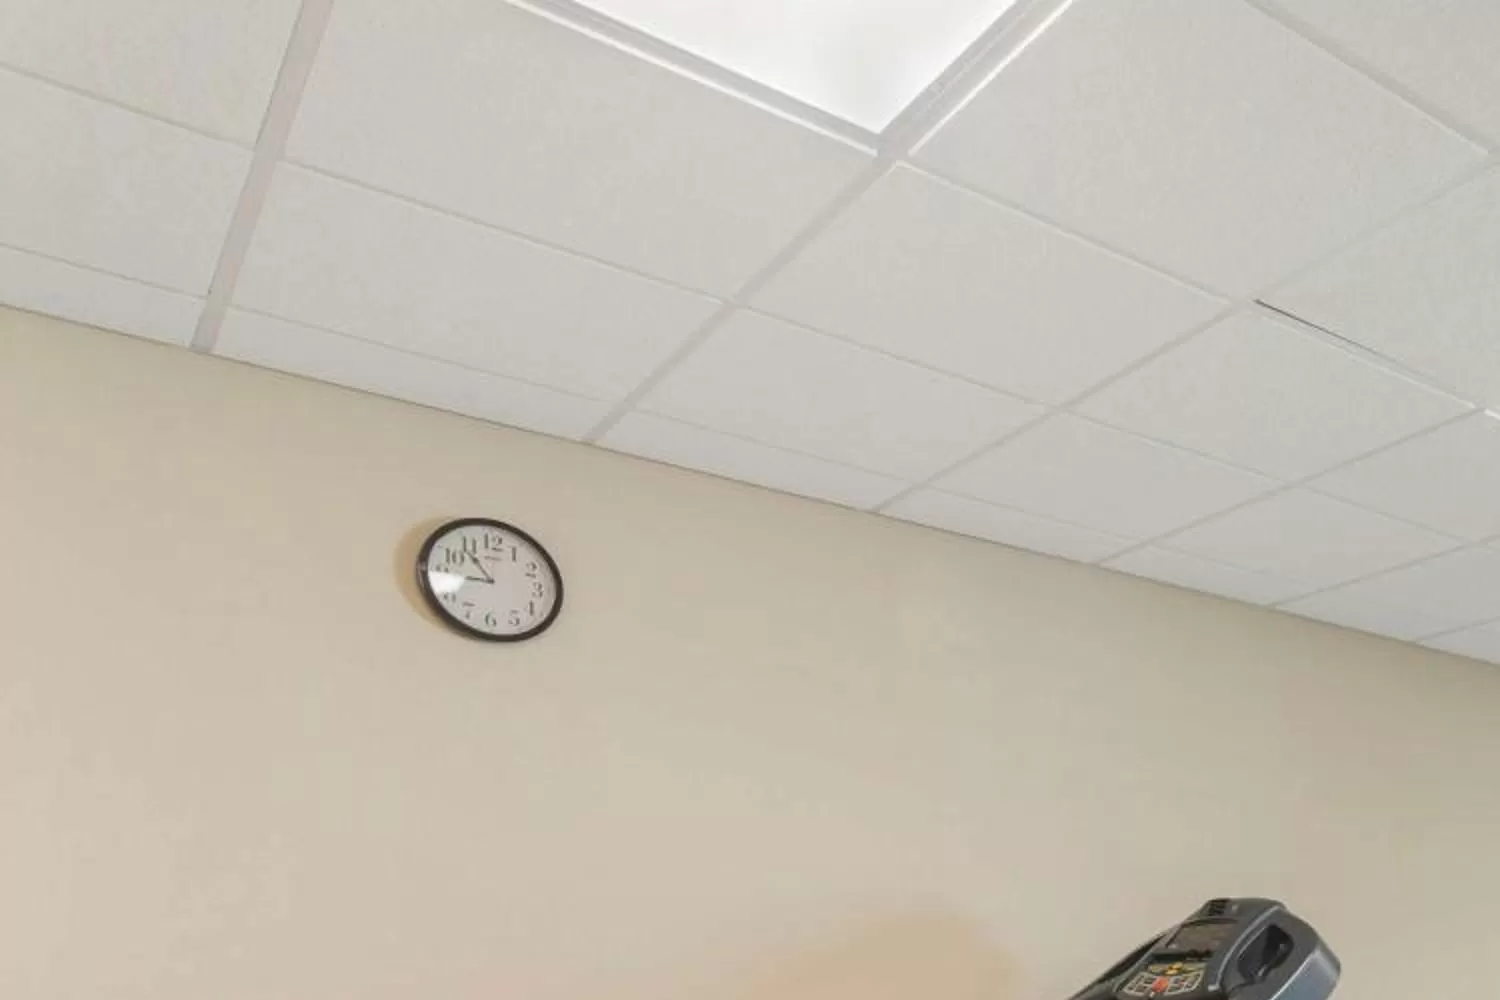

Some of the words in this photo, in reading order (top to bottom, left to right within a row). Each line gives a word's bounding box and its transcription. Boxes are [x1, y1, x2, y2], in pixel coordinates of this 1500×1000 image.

[463, 536, 477, 554] 11
[484, 533, 503, 552] 12
[445, 548, 464, 565] 10
[508, 546, 517, 563] 1
[525, 561, 537, 578] 2
[485, 612, 497, 627] 6
[508, 610, 520, 626] 5
